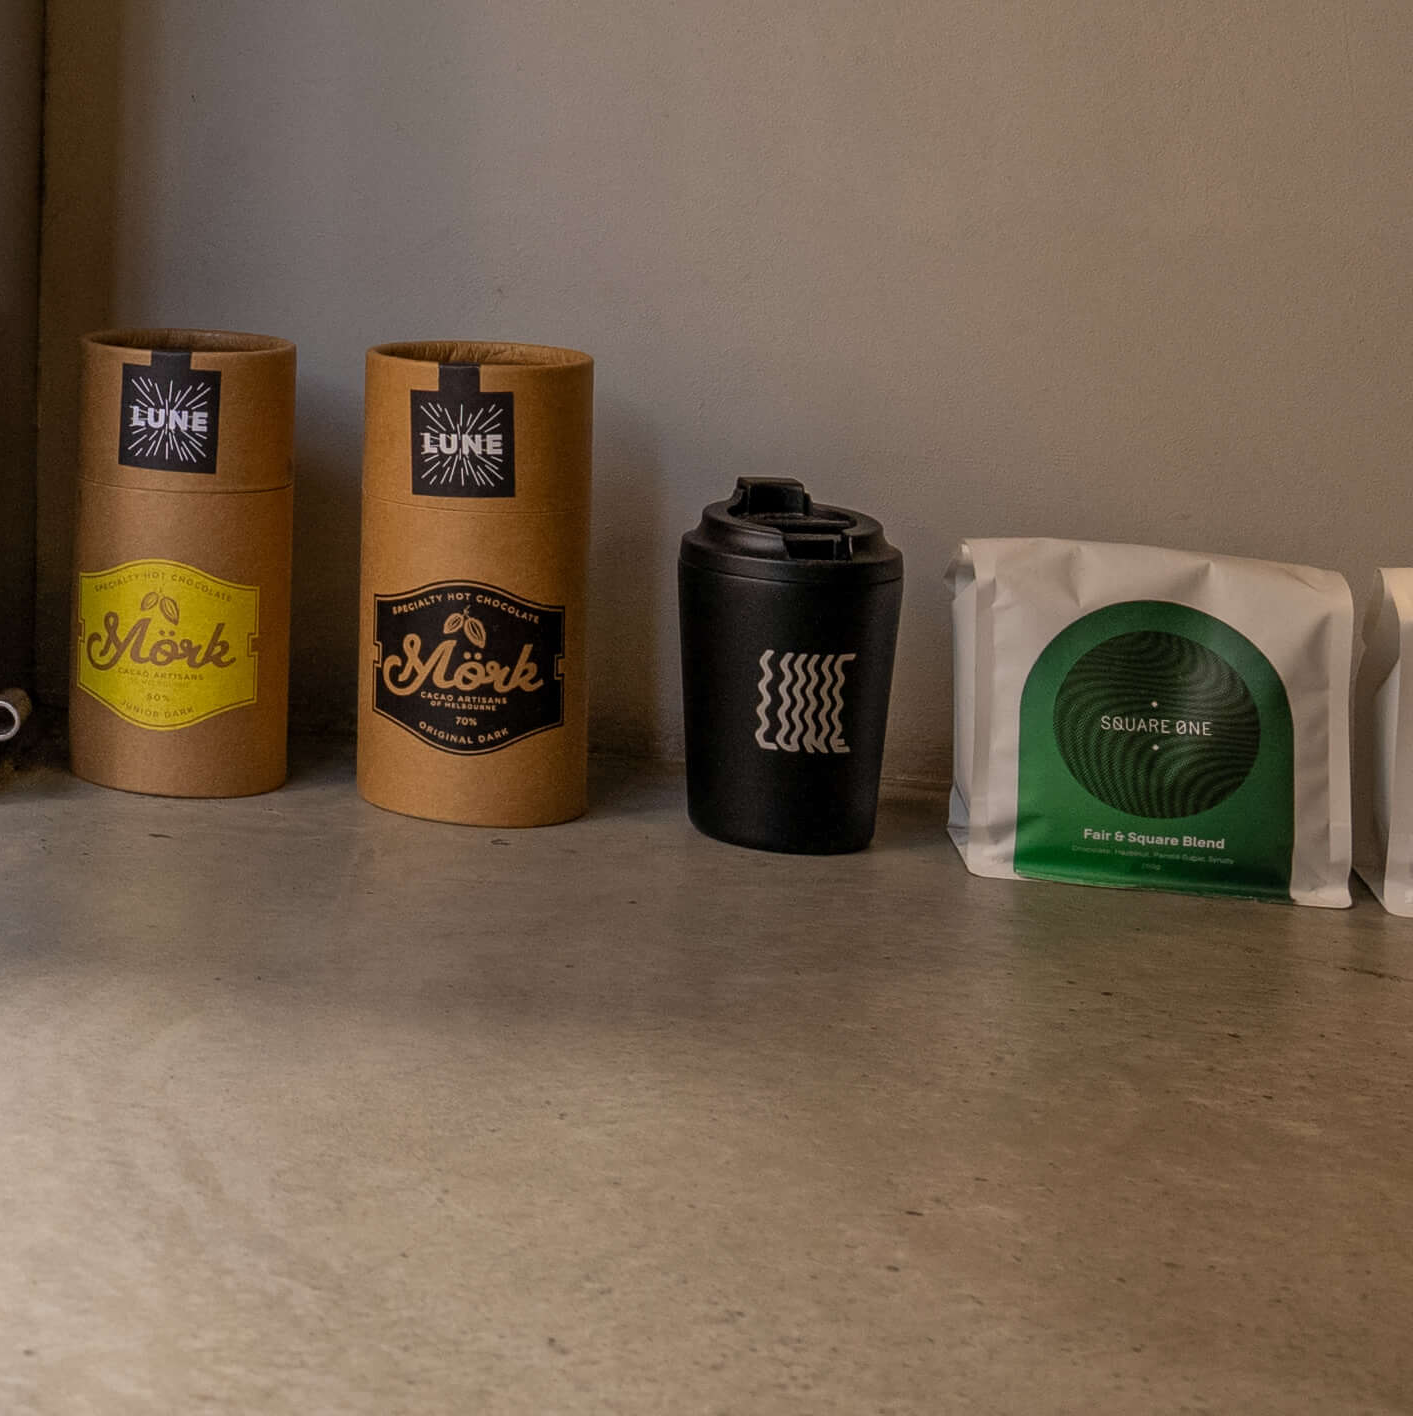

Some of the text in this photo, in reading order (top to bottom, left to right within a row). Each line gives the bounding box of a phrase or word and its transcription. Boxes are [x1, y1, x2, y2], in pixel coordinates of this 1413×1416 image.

[130, 404, 208, 433] LUNE
[422, 432, 503, 456] LUNE
[391, 592, 540, 624] SPECIALTY HOT CHOCOLATE
[86, 611, 237, 671] Mörk
[383, 633, 544, 696] Mörk
[420, 690, 508, 705] CACAO ARTISANS
[444, 702, 497, 712] MELBOURNE
[418, 720, 510, 744] ORIGINAL DARK
[454, 715, 478, 726] 70%
[1100, 715, 1171, 734] SQUARE
[1083, 828, 1225, 849] Fair & Square Blend
